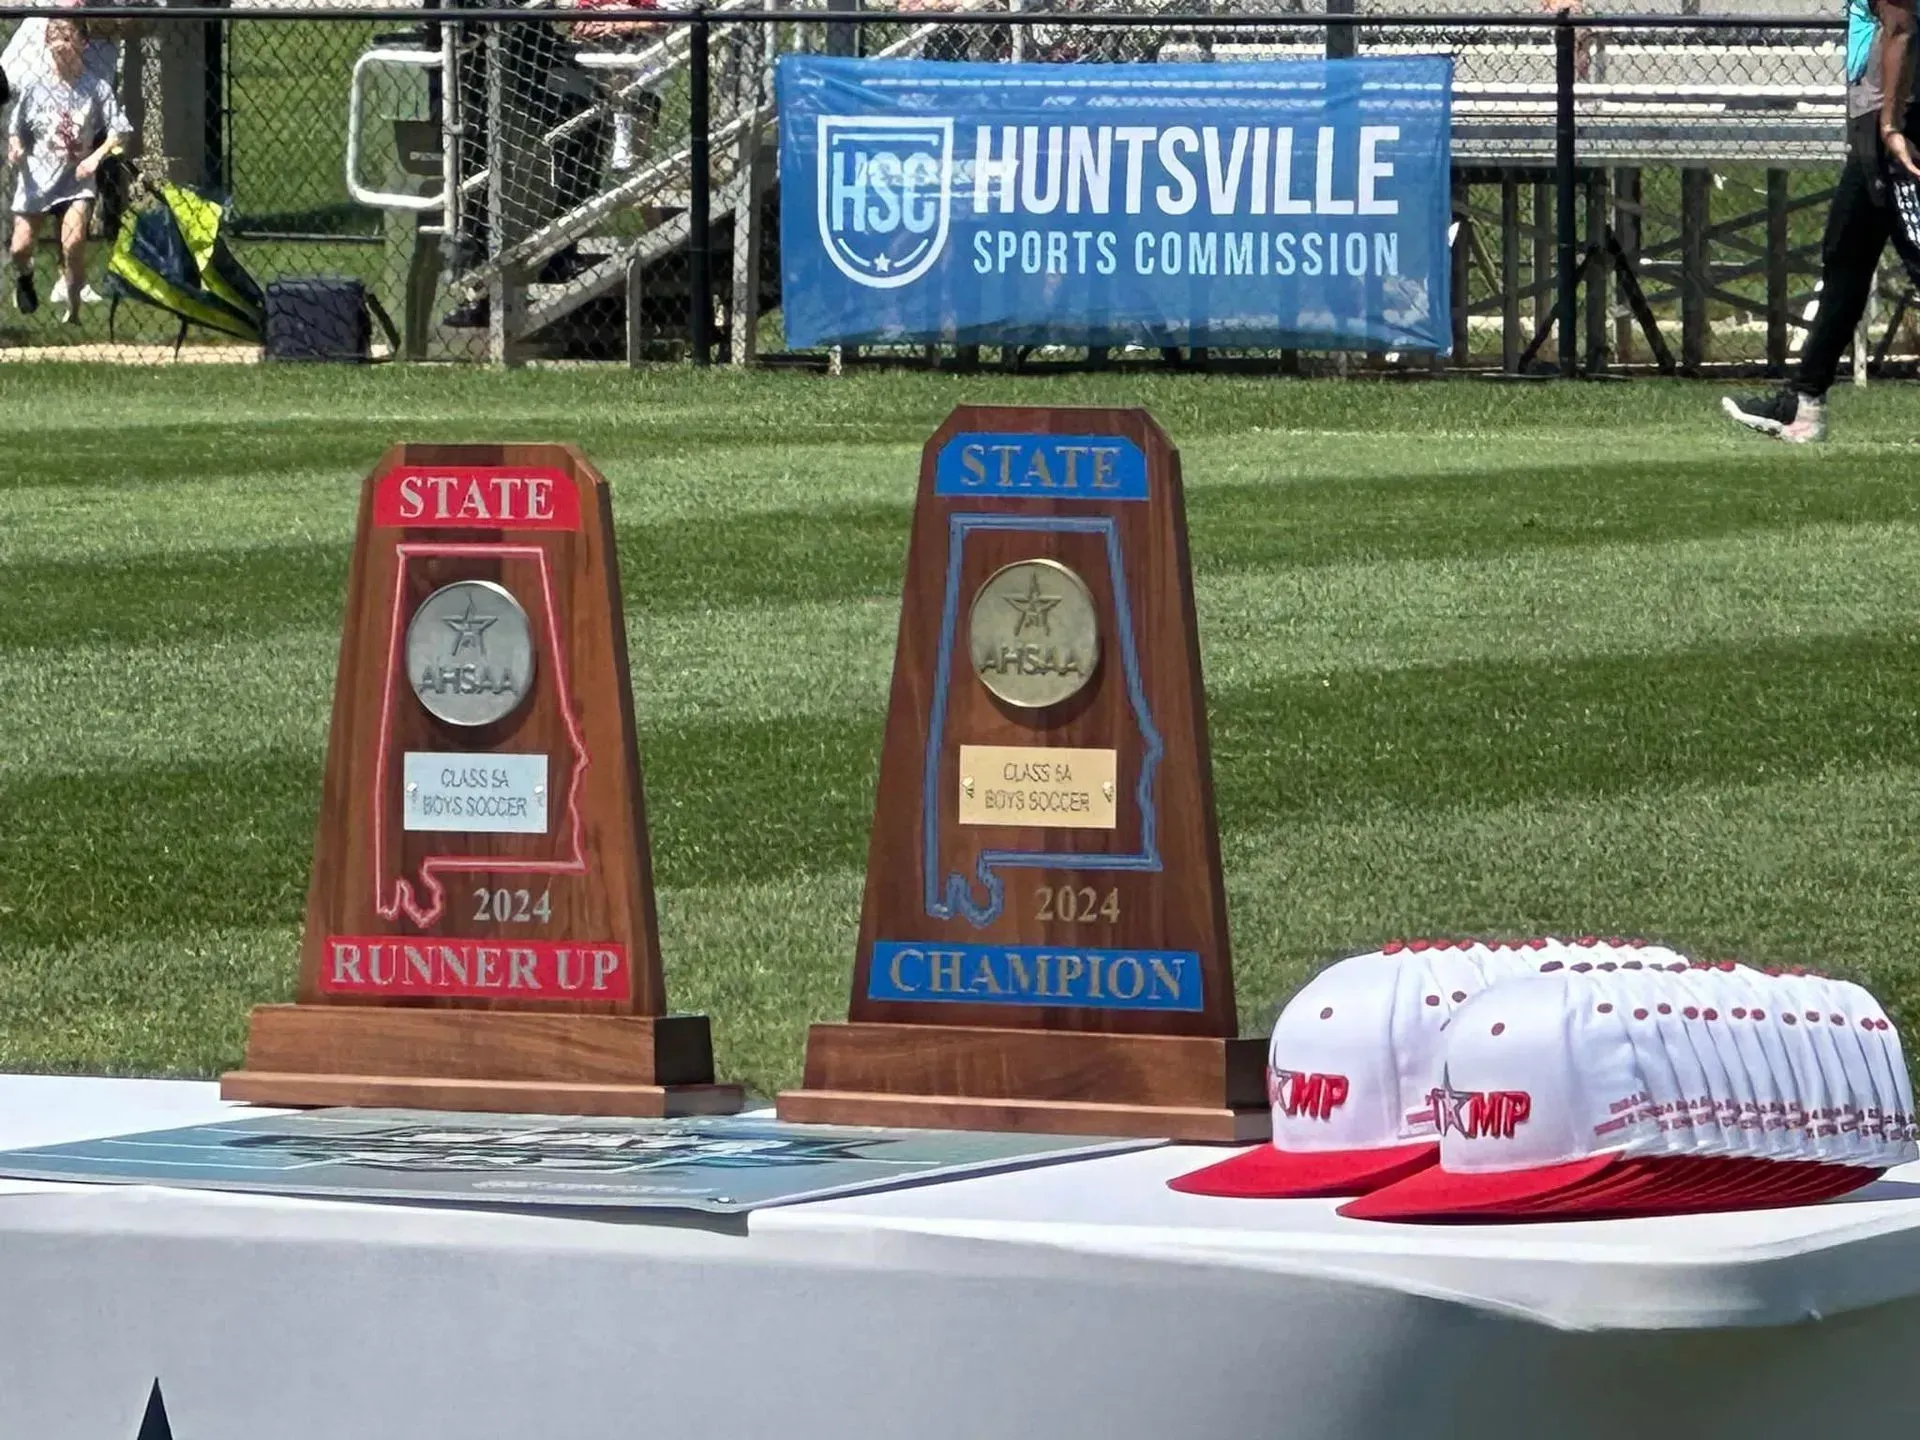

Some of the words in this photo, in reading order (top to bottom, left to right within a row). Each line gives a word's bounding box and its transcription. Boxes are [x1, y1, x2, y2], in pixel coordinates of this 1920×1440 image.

[973, 126, 1400, 215] HUNTSVILLE
[832, 151, 937, 233] HSC
[973, 230, 1117, 275] SPORTS
[1135, 231, 1399, 276] COMMISSION
[960, 443, 1123, 488] STATE
[399, 475, 555, 520] STATE
[418, 662, 520, 695] AHSAA
[979, 643, 1085, 678] AHSAA
[440, 768, 488, 789] CLASS
[1003, 762, 1051, 783] CLASS
[422, 794, 463, 817] BOYS
[466, 795, 528, 818] SOCCER
[984, 788, 1025, 812] BOYS
[1029, 790, 1091, 813] SOCCER
[472, 887, 552, 925] 2024
[1034, 884, 1121, 924] 2024
[331, 942, 543, 989] RUNNER
[556, 949, 620, 991] UP
[889, 948, 1186, 1001] CHAMPION
